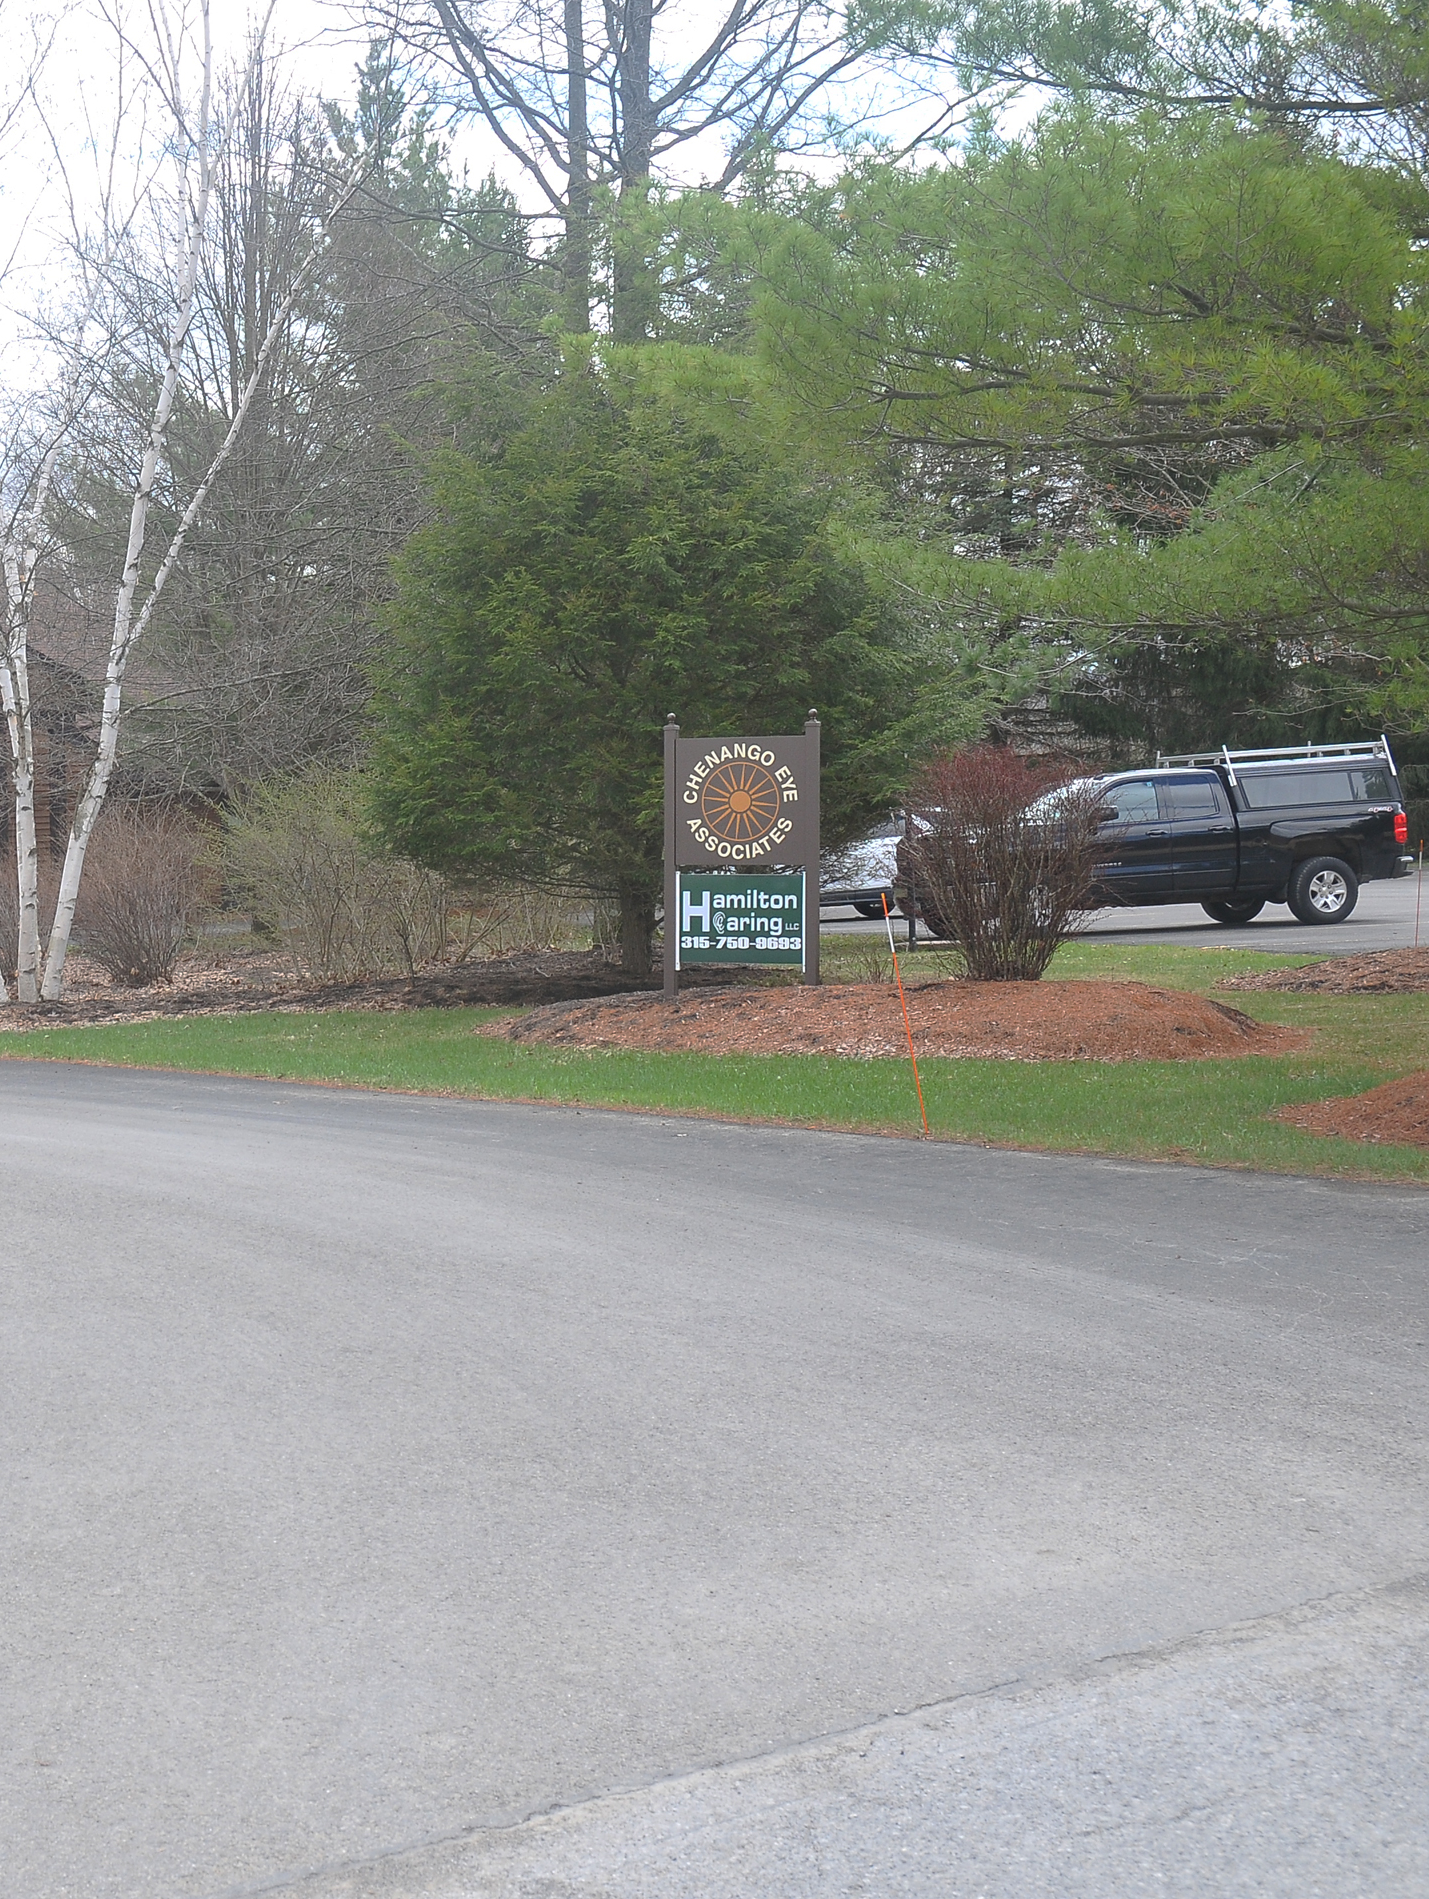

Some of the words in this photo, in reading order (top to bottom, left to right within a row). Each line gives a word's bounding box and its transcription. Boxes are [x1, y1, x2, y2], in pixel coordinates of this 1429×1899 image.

[683, 743, 776, 804] CHENANGO
[774, 765, 798, 803] EYE
[686, 816, 793, 860] ASSOCIATES
[682, 889, 798, 932] Hamilton
[785, 923, 800, 931] LLC
